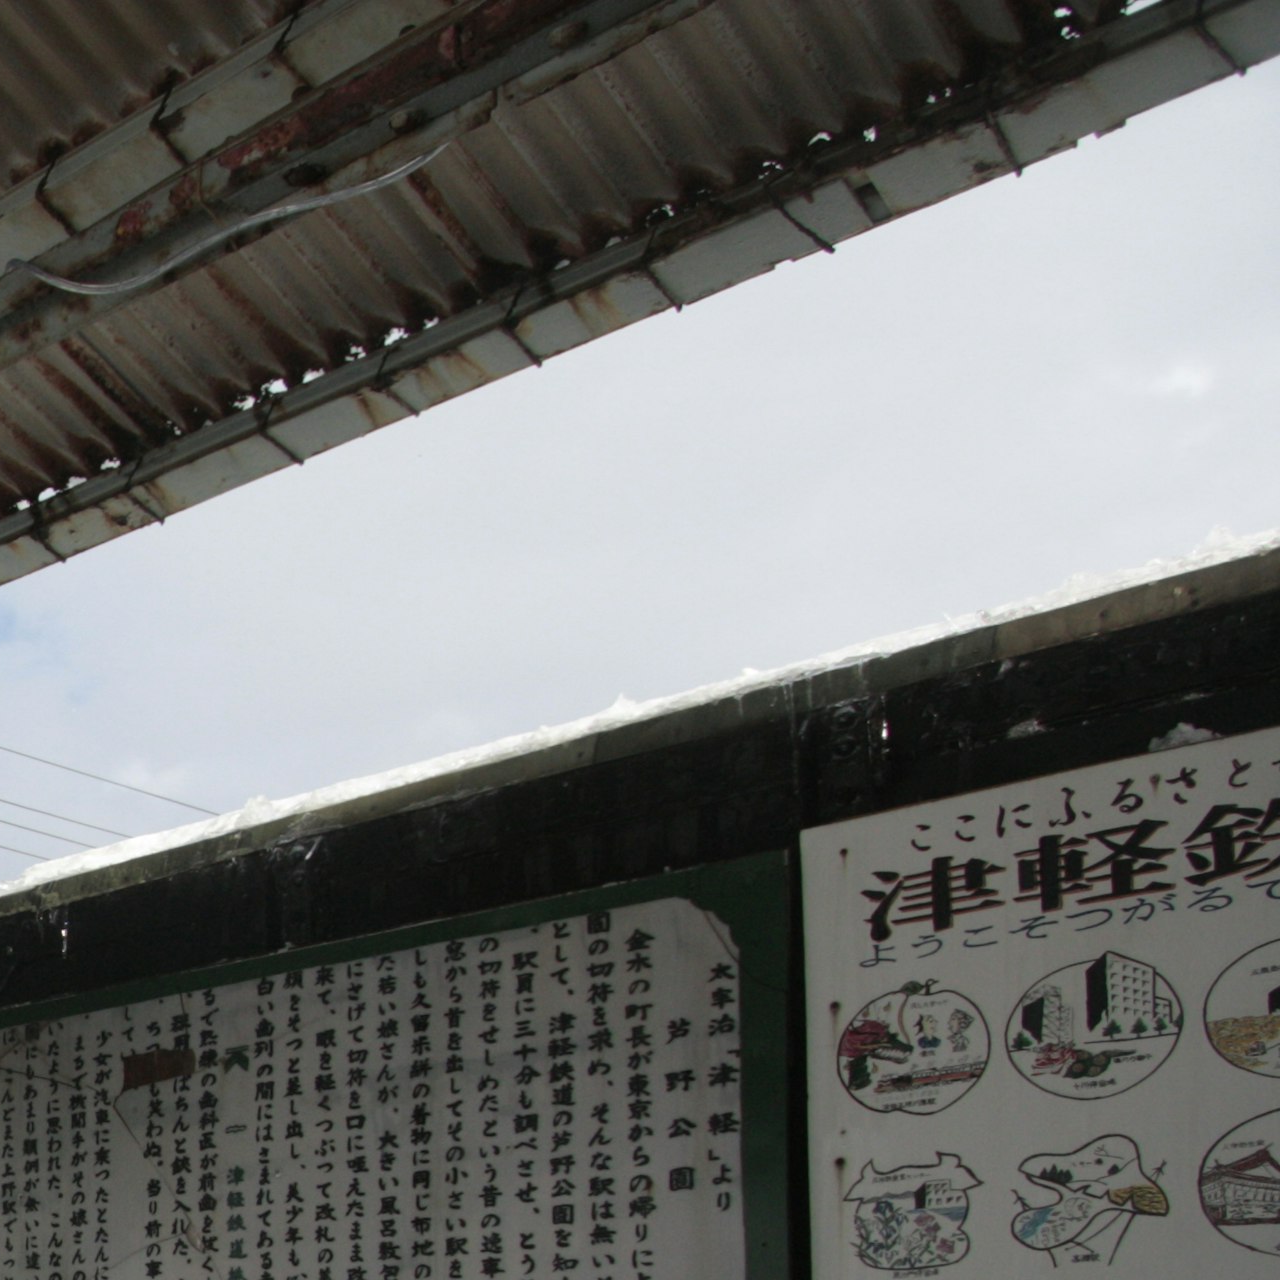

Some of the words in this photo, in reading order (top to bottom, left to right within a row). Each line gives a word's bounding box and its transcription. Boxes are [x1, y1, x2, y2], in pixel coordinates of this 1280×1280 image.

[910, 758, 1280, 852] ここにふるさと
[665, 1018, 697, 1191] 芦野公園
[706, 961, 740, 1213] 太宰治「津軽」より
